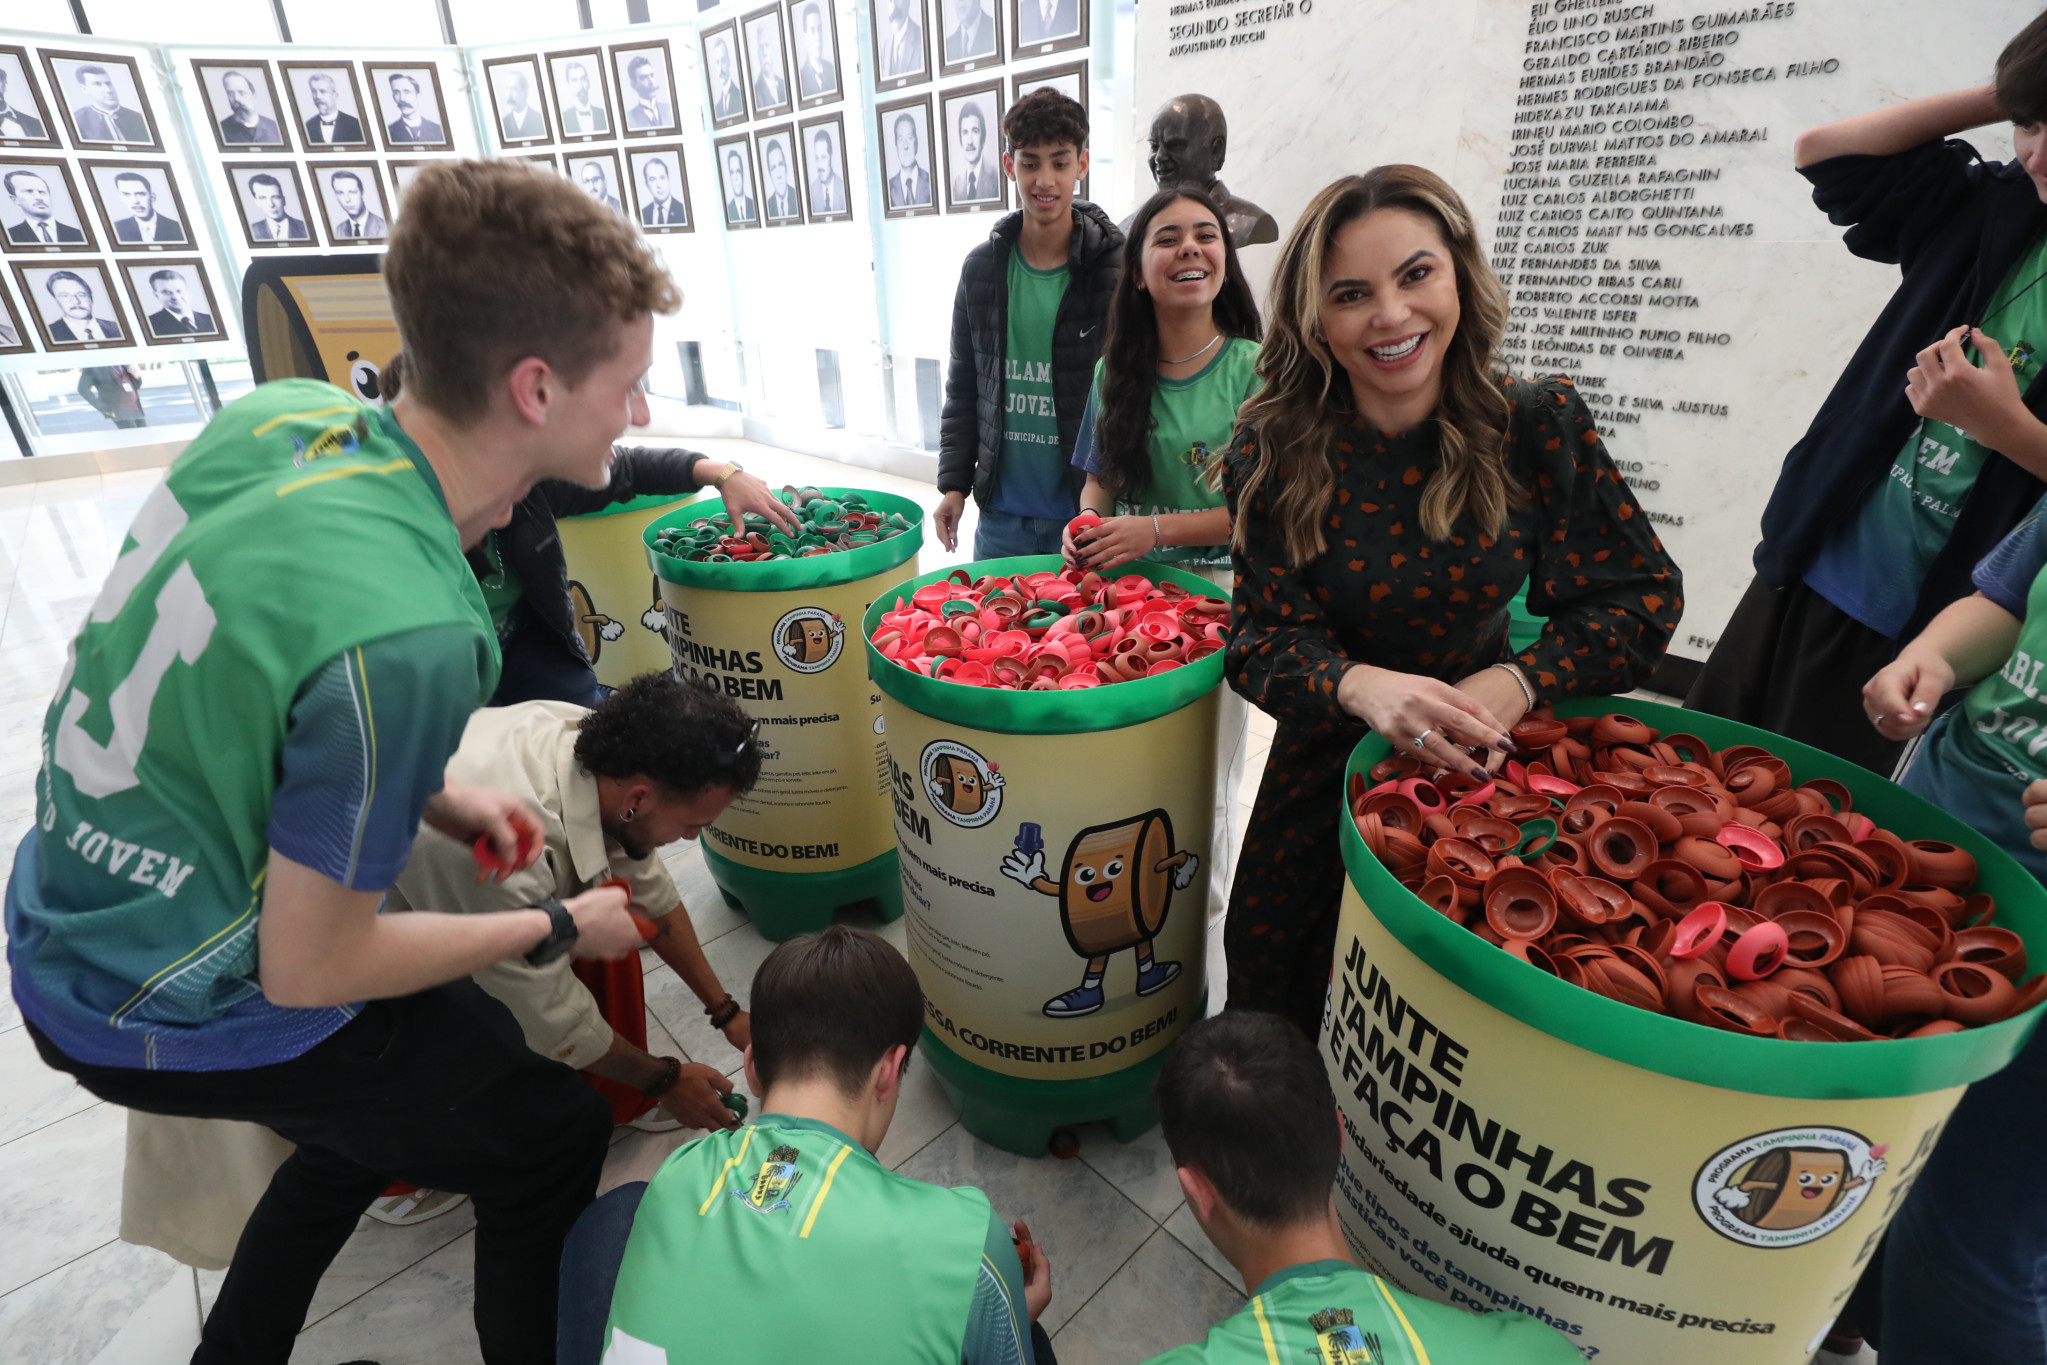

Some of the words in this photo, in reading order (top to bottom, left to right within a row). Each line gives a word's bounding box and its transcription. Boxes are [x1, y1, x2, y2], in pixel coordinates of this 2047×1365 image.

[1528, 16, 1558, 36] ÉLIO
[1562, 13, 1598, 31] LINO
[1603, 6, 1655, 25] RUSCH
[1531, 2, 1548, 18] ELI
[1169, 17, 1229, 40] SEGUNDO
[1525, 30, 1610, 54] FRANCISCO
[1615, 20, 1683, 41] MARTINS
[1692, 1, 1796, 30] GUIMARÃES
[1169, 38, 1227, 56] AUGUSTINHO
[1230, 30, 1265, 46] ZUCCHI
[1523, 51, 1591, 71] GERALDO
[1597, 38, 1671, 63] CARTÁRIO
[1678, 31, 1740, 51] RIBEIRO
[1517, 90, 1568, 106] HERMES
[1573, 79, 1657, 101] RODRIGUES
[1663, 77, 1684, 92] DA
[1692, 66, 1776, 88] FONSECA
[1785, 58, 1840, 79] FILHO
[1519, 71, 1575, 89] HERMAS
[1644, 50, 1725, 75] BRANDÃO
[1514, 105, 1584, 124] HIDEKAZU
[1590, 97, 1669, 117] TAKAIAMA
[1511, 126, 1555, 141] IRINEU
[1559, 121, 1607, 137] MARIO
[1612, 114, 1694, 133] COLOMBO
[1509, 140, 1545, 157] JOSÉ
[1549, 140, 1598, 155] DURVAL
[1603, 135, 1664, 151] MATTOS
[1669, 133, 1695, 147] DO
[1700, 127, 1768, 145] AMARAL
[1547, 158, 1589, 172] MARIA
[1595, 154, 1657, 169] FERREIRA
[1503, 176, 1561, 190] LUCIANA
[1568, 173, 1631, 187] GUZELLA
[1638, 168, 1720, 184] RAFAGNIN
[1501, 194, 1527, 206] LUIZ
[1533, 192, 1586, 205] CARLOS
[1591, 187, 1695, 202] ALBORGHETTI
[1498, 210, 1524, 222] LUIZ
[1530, 208, 1583, 221] CARLOS
[1589, 206, 1634, 220] CAITO
[1642, 205, 1724, 219] QUINTANA
[1496, 226, 1522, 238] LUIZ
[1527, 225, 1580, 238] CARLOS
[1654, 223, 1754, 238] GONÇALVES
[1493, 242, 1518, 254] LUIZ
[1524, 242, 1575, 254] CARLOS
[1580, 242, 1610, 254] ZUK
[1491, 258, 1516, 270] LUIZ
[1521, 258, 1598, 270] FERNANDES
[1603, 259, 1622, 271] DA
[1628, 259, 1662, 271] SILVA
[1518, 274, 1593, 287] FERNANDO
[1597, 276, 1635, 288] RIBAS
[1641, 277, 1683, 289] CARLI
[1516, 291, 1573, 304] ROBERTO
[1578, 292, 1643, 306] ACCORSI
[1648, 294, 1700, 308] MOTTA
[1543, 307, 1597, 321] VALENTE
[1602, 310, 1638, 322] ISFER
[1506, 322, 1526, 334] ON
[1531, 323, 1565, 336] JOSE
[1570, 325, 1634, 339] MILTINHO
[1639, 329, 1681, 342] PUPIO
[1687, 331, 1731, 345] FILHO
[1504, 353, 1526, 366] ON
[1531, 355, 1582, 369] GARCIA
[1600, 343, 1616, 356] DE
[1622, 345, 1684, 360] OLIVEIRA
[1582, 392, 1613, 405] CIDO
[1619, 396, 1626, 407] E
[1632, 396, 1664, 411] SILVA
[1672, 400, 1728, 416] JUSTUS
[723, 675, 783, 701] BEM
[771, 715, 798, 725] mais
[800, 713, 840, 727] precisa
[65, 821, 196, 899] JOVEM
[760, 842, 789, 859] DO
[791, 843, 839, 860] BEM!
[922, 861, 947, 882] mais
[949, 874, 996, 896] precisa
[1345, 935, 1470, 1087] JUNTE
[959, 1028, 1085, 1063] CORRENTE
[1089, 1036, 1127, 1060] DO
[1130, 1006, 1178, 1047] BEM!
[1340, 971, 1653, 1218] TAMPINHAS
[1330, 1015, 1348, 1066] E
[1342, 1043, 1444, 1182] FAÇA
[1454, 1162, 1506, 1209] O
[1510, 1190, 1675, 1277] BEM
[1708, 1146, 1755, 1184] PROGRAMA
[1754, 1133, 1817, 1150] TAMPINHA
[1708, 1204, 1757, 1241] PROGRAMA
[1759, 1225, 1822, 1243] TAMPINHA
[1365, 1189, 1411, 1241] tipos
[1412, 1236, 1441, 1265] de
[1444, 1260, 1584, 1337] tampinhas
[1399, 1247, 1449, 1293] você
[1447, 1216, 1521, 1271] ajuda
[1524, 1264, 1605, 1304] quem
[1607, 1292, 1677, 1323] mais
[1677, 1312, 1776, 1335] precisa
